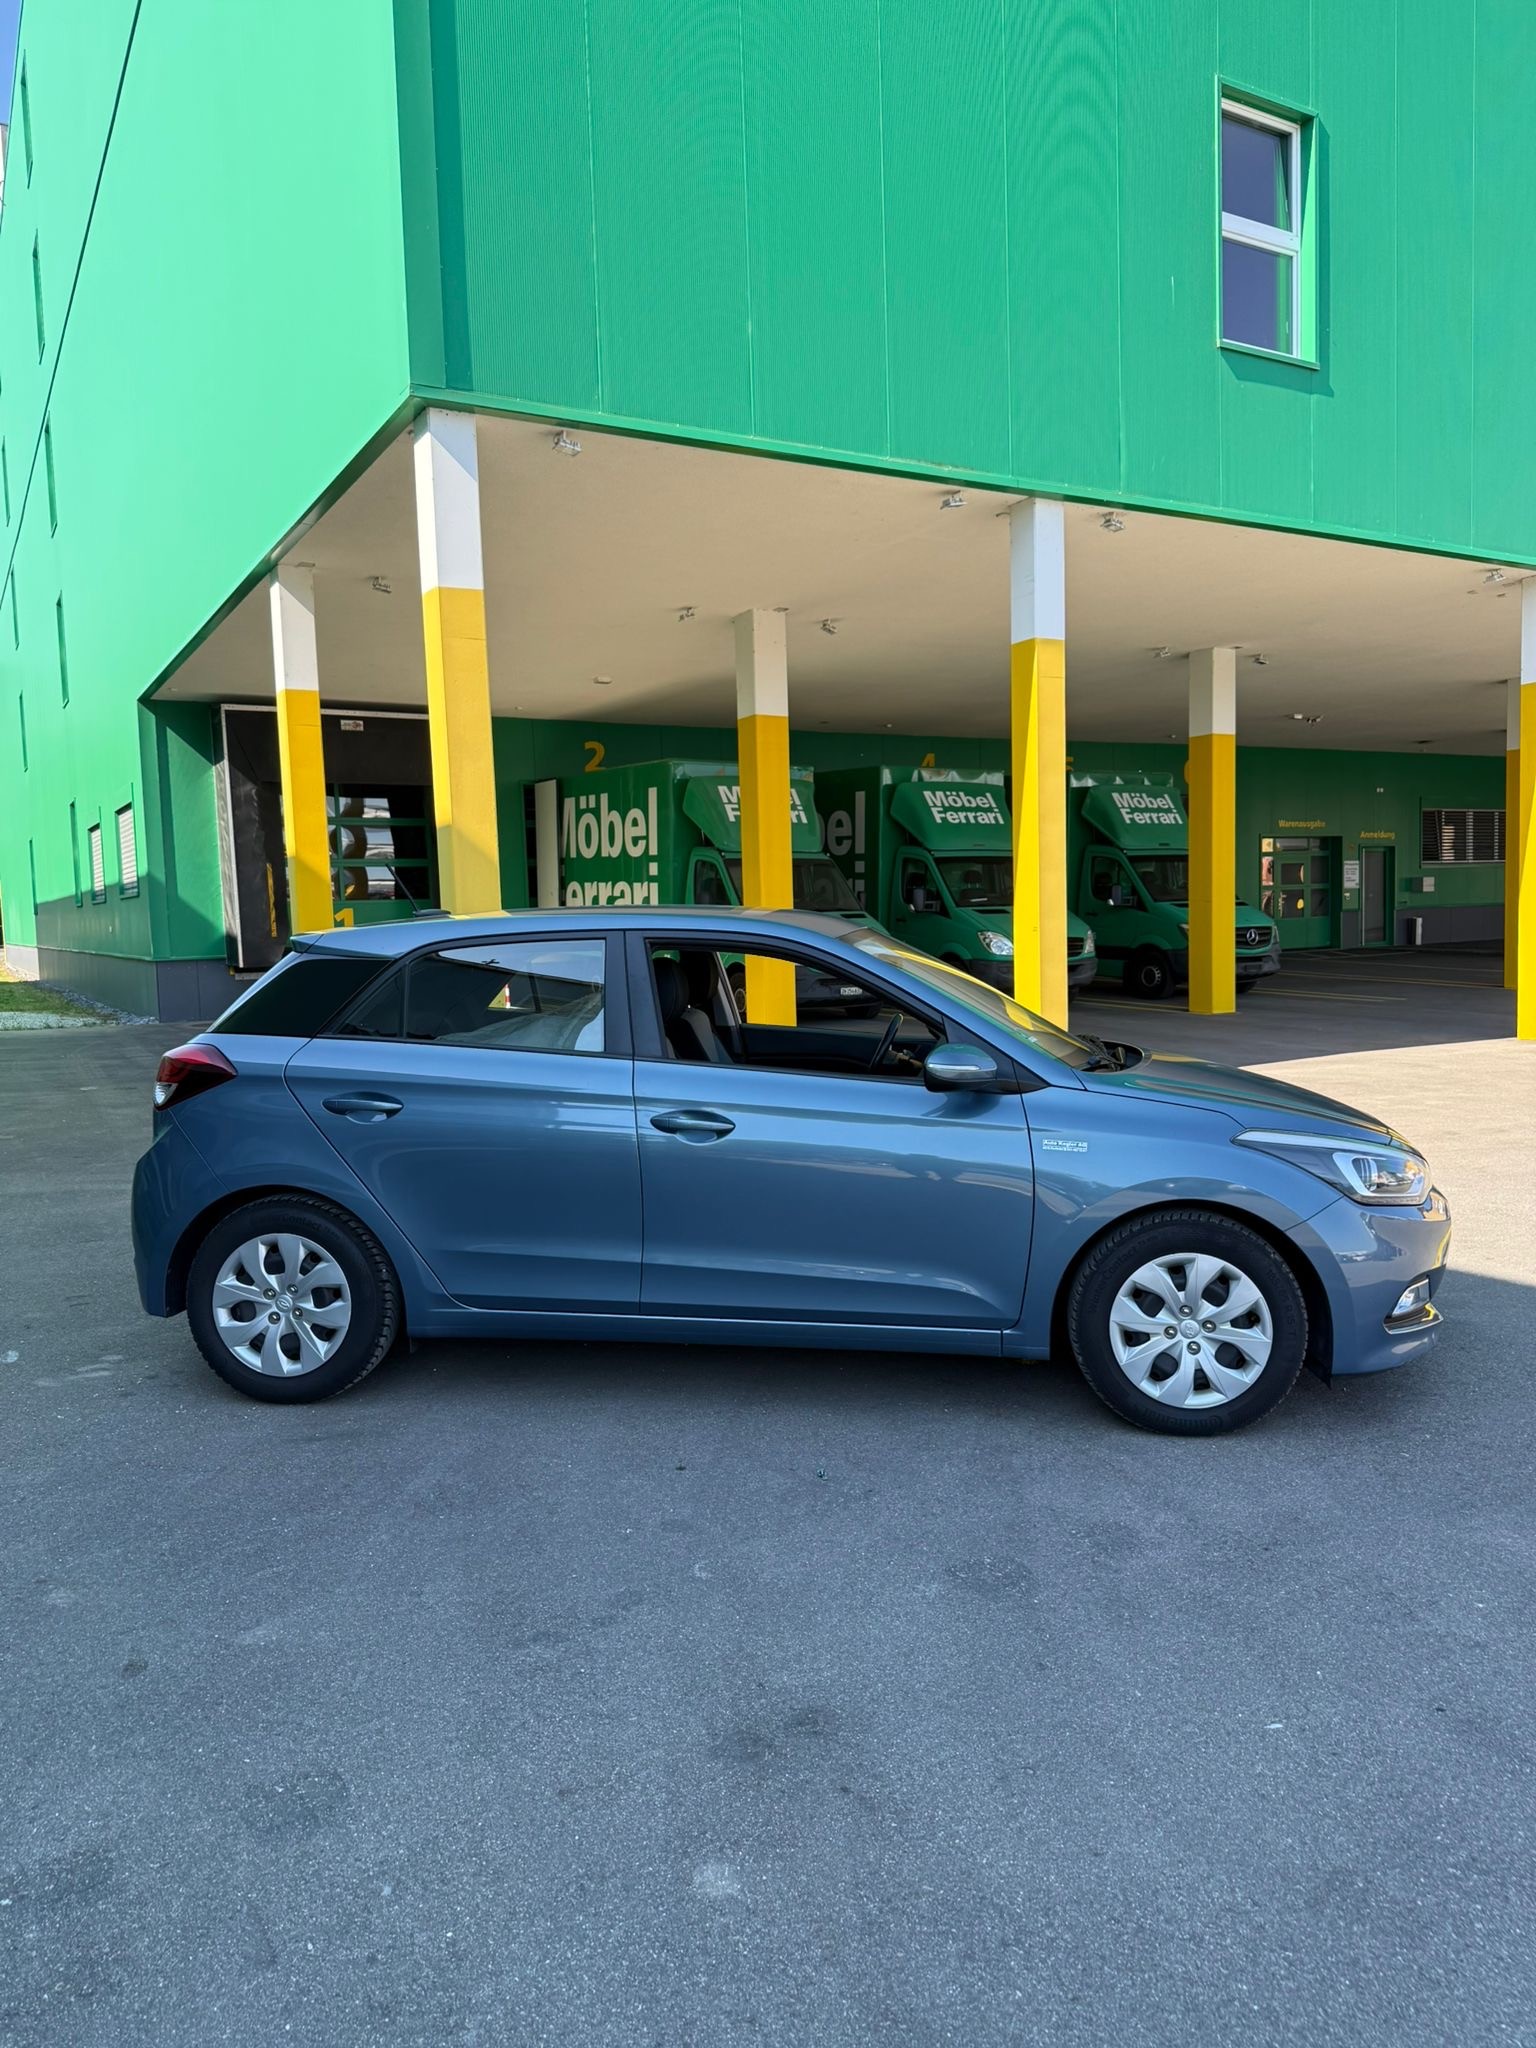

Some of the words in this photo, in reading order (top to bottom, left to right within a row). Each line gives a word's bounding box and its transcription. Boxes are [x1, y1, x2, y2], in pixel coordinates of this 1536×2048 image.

[584, 740, 607, 772] 2
[923, 790, 998, 808] Möbel
[1112, 792, 1175, 809] Möbel
[930, 807, 1004, 825] Ferrari
[1120, 808, 1183, 825] Ferrari
[564, 862, 659, 907] errari
[335, 908, 354, 928] 1
